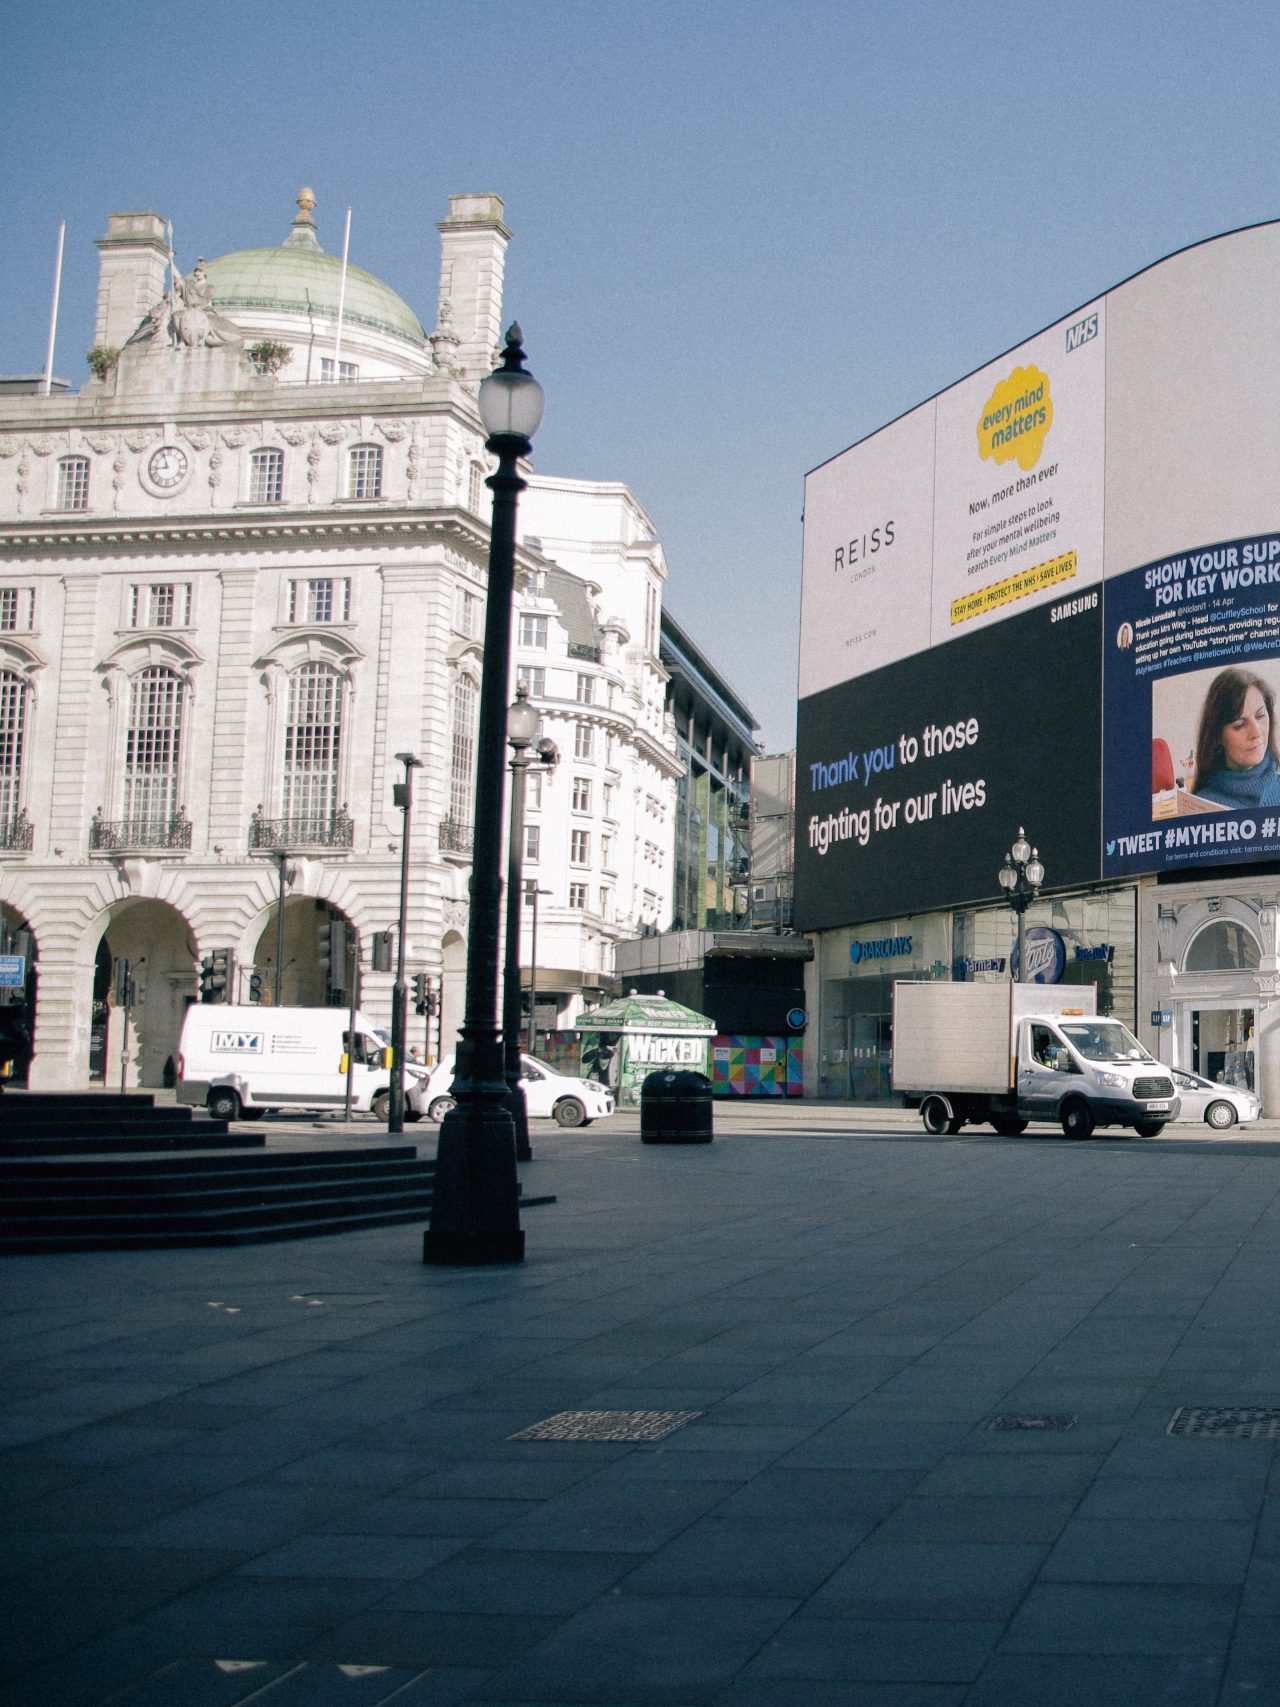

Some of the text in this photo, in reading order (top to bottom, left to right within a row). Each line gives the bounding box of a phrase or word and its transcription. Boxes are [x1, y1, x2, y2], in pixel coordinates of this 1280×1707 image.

[1067, 314, 1097, 351] NHS
[983, 382, 1044, 431] every mind
[991, 406, 1047, 449] matters
[968, 462, 1058, 516] Now, more than ever
[966, 511, 1060, 561] after your mental wellbeing
[973, 497, 1054, 543] For simple steps to look
[834, 520, 895, 572] REISS
[967, 529, 1057, 576] search Every Mind Matters
[1144, 559, 1187, 590] SHOW
[1189, 547, 1238, 576] YOUR
[954, 559, 1072, 617] STAY HOME PROTECT THE NHS SAVE LIVES
[1155, 582, 1183, 607] FOR
[1186, 574, 1218, 598] KEY
[1221, 598, 1234, 609] Apr
[1051, 592, 1098, 623] SAMSUNG
[1135, 632, 1150, 641] Thank
[1150, 629, 1160, 640] you
[1160, 625, 1171, 634] Mrs
[1171, 621, 1187, 633] Wing
[1191, 615, 1209, 626] Head
[1267, 603, 1279, 612] for
[1135, 641, 1159, 654] education
[1159, 636, 1174, 648] going
[1174, 632, 1194, 643] during
[1194, 624, 1228, 637] lockdown,
[1228, 617, 1263, 632] providing
[1152, 652, 1159, 660] up
[1159, 648, 1169, 657] her
[1182, 640, 1208, 652] YouTube
[1249, 626, 1280, 639] channel
[1163, 654, 1193, 668] #Teachers
[810, 717, 979, 791] Thank you to those
[808, 778, 986, 855] fighting for our lives
[1117, 830, 1163, 856] TWEET
[1164, 819, 1257, 849] #MYHERO
[1173, 852, 1188, 860] terms
[1189, 850, 1199, 858] and
[1199, 847, 1229, 857] conditions
[862, 935, 913, 961] BARCLAYS
[962, 957, 1001, 974] harmay
